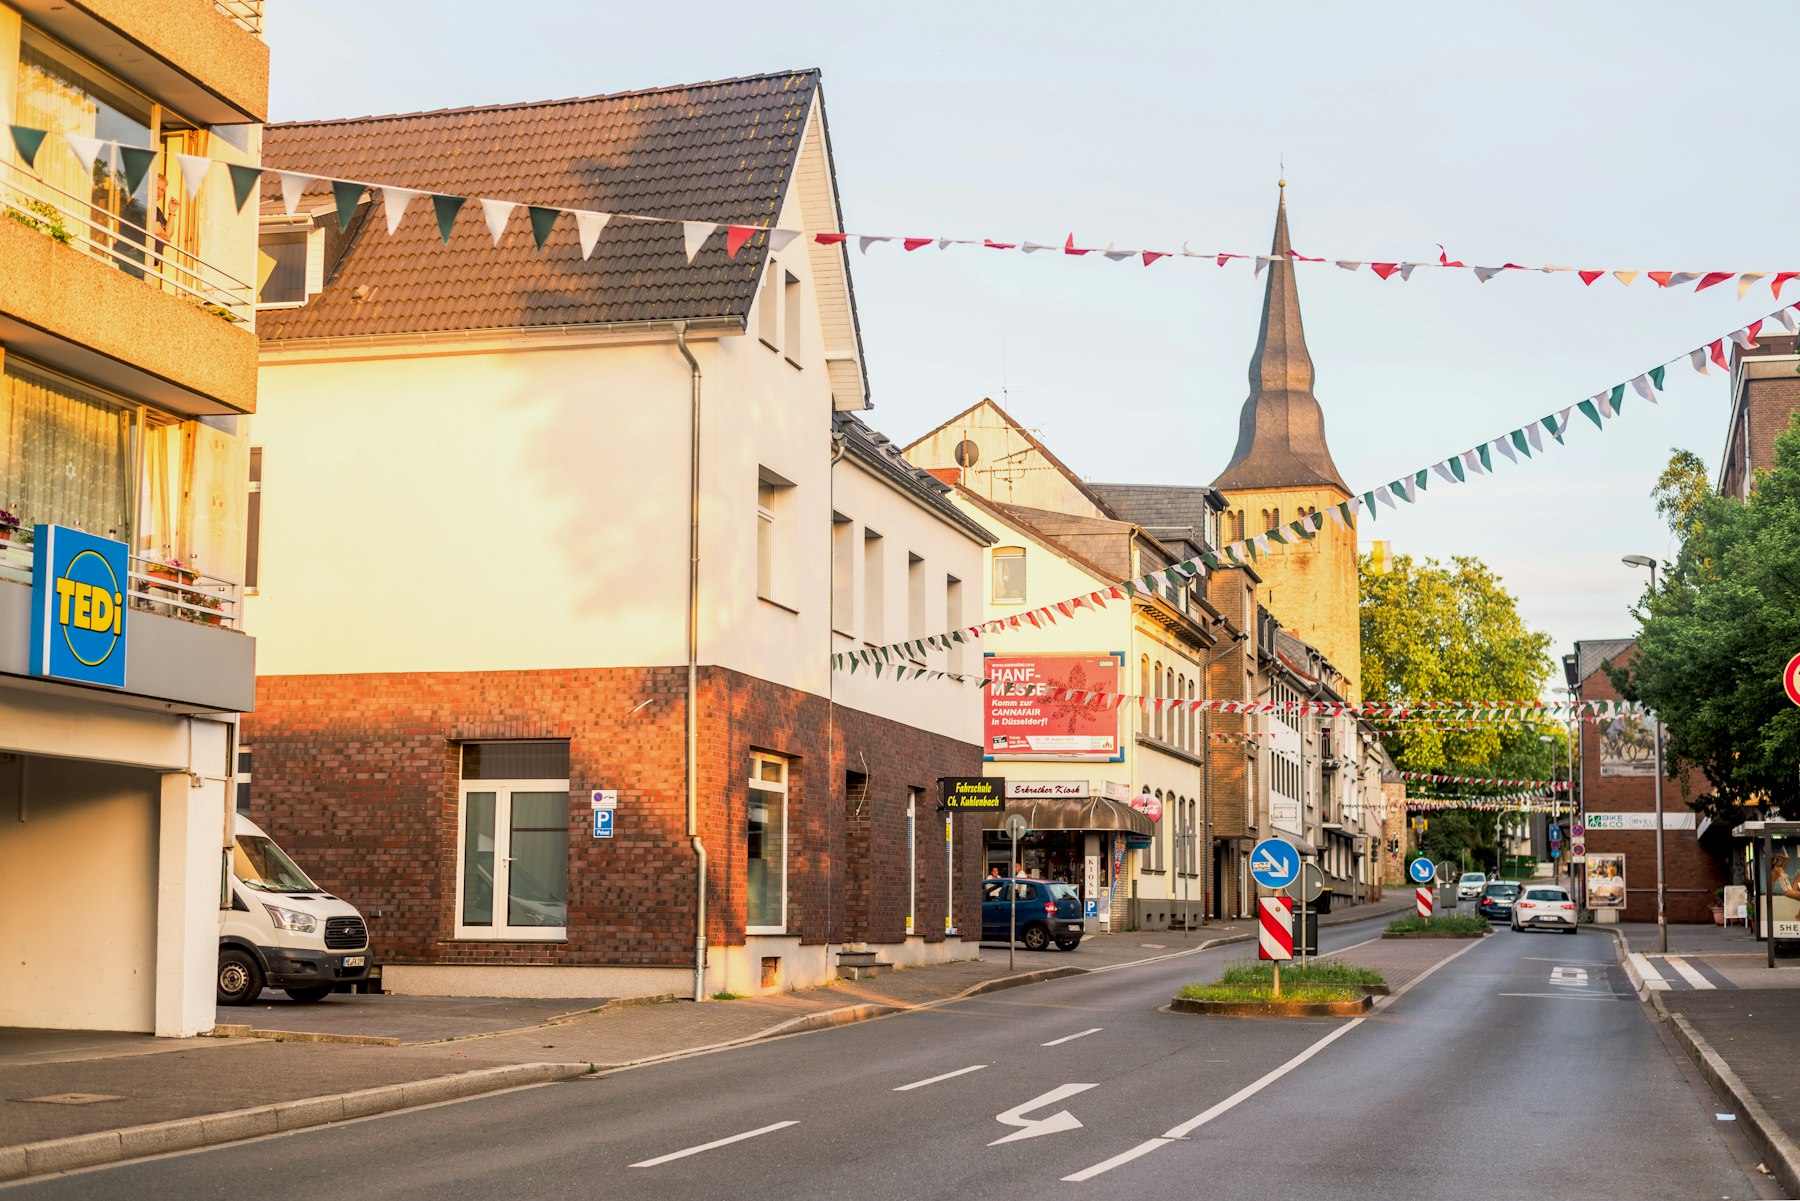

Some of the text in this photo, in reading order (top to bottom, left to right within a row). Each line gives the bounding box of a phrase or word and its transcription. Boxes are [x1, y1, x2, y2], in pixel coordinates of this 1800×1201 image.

[56, 576, 123, 637] TEDi
[991, 668, 1041, 681] HANF-
[991, 708, 1041, 716] CANNAFAIR
[1001, 717, 1048, 727] Düsseldorf!
[955, 782, 992, 793] Fahrschule
[1014, 785, 1080, 794] Erkrather Kiosk
[947, 795, 1000, 807] Ch. Kuhlenbach
[597, 811, 609, 828] P
[1087, 901, 1095, 911] P
